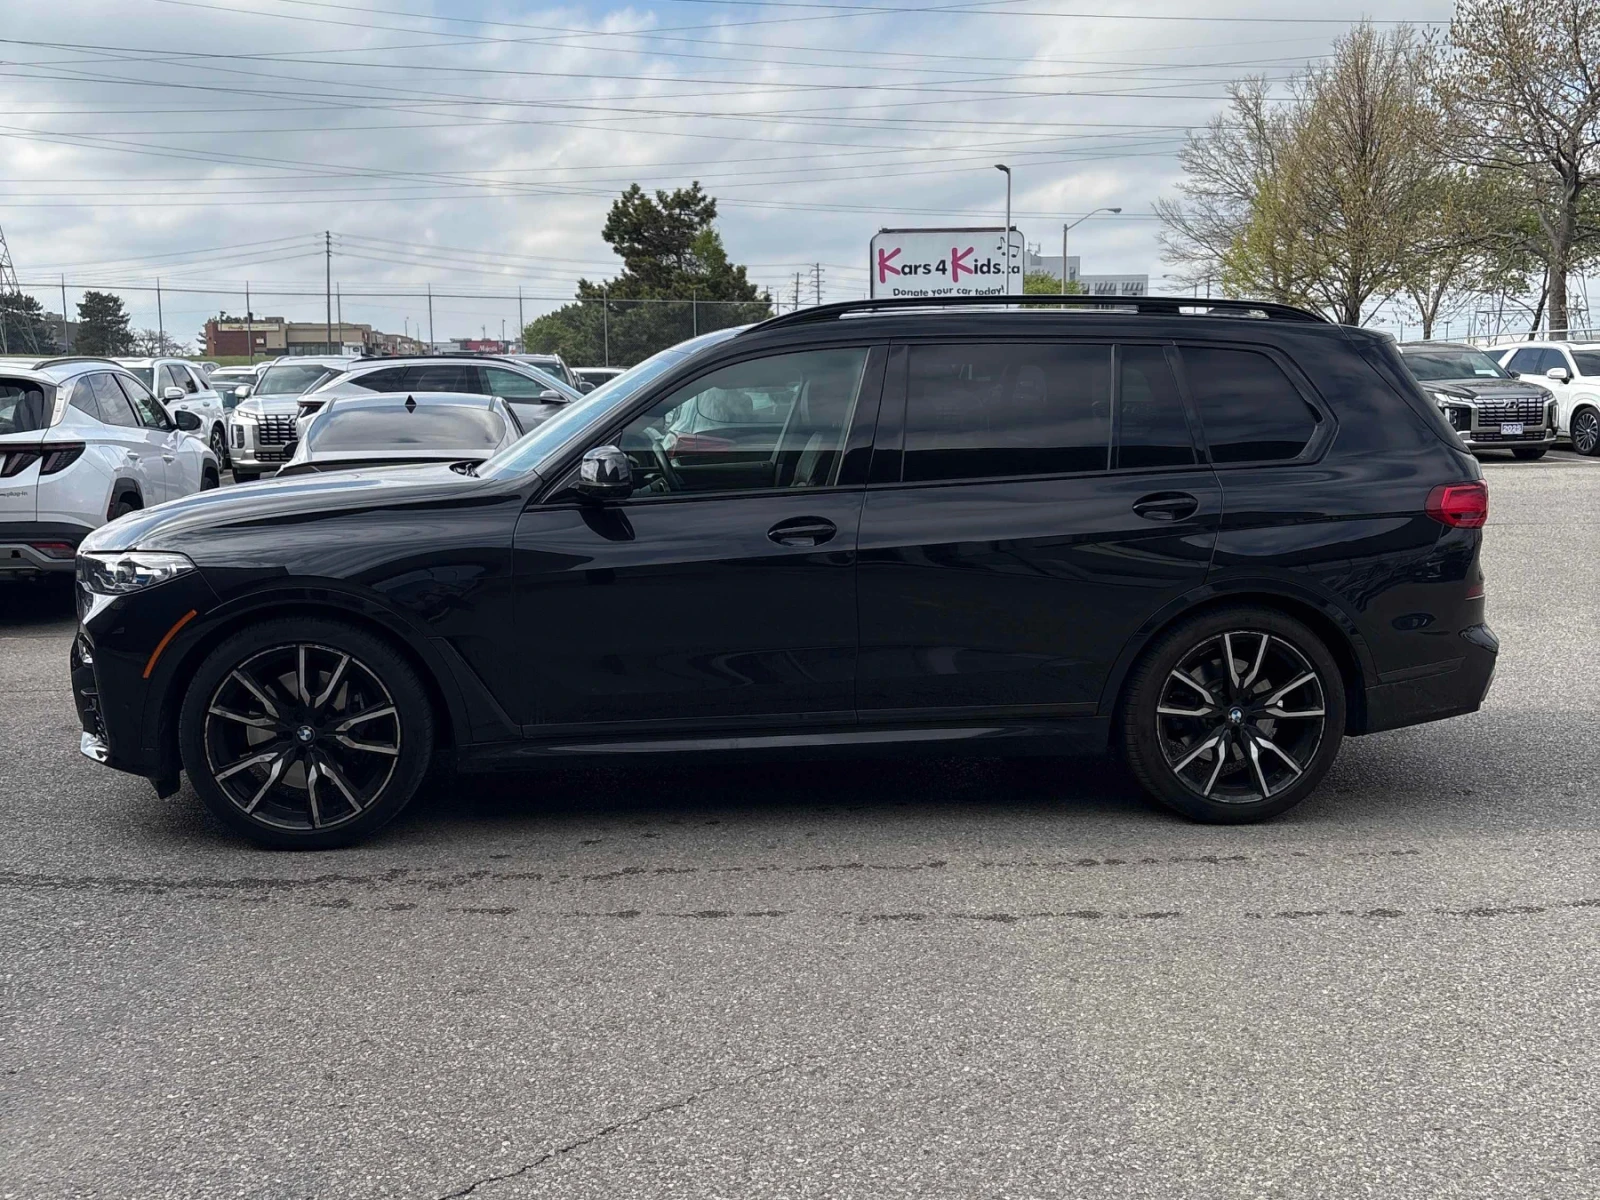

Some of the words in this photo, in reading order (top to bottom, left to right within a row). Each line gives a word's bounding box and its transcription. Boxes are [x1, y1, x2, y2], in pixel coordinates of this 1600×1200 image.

[878, 247, 932, 284] Kars
[935, 259, 948, 276] 4
[892, 287, 929, 297] Donate
[930, 286, 954, 297] your
[956, 287, 973, 296] car
[975, 284, 1006, 296] today!
